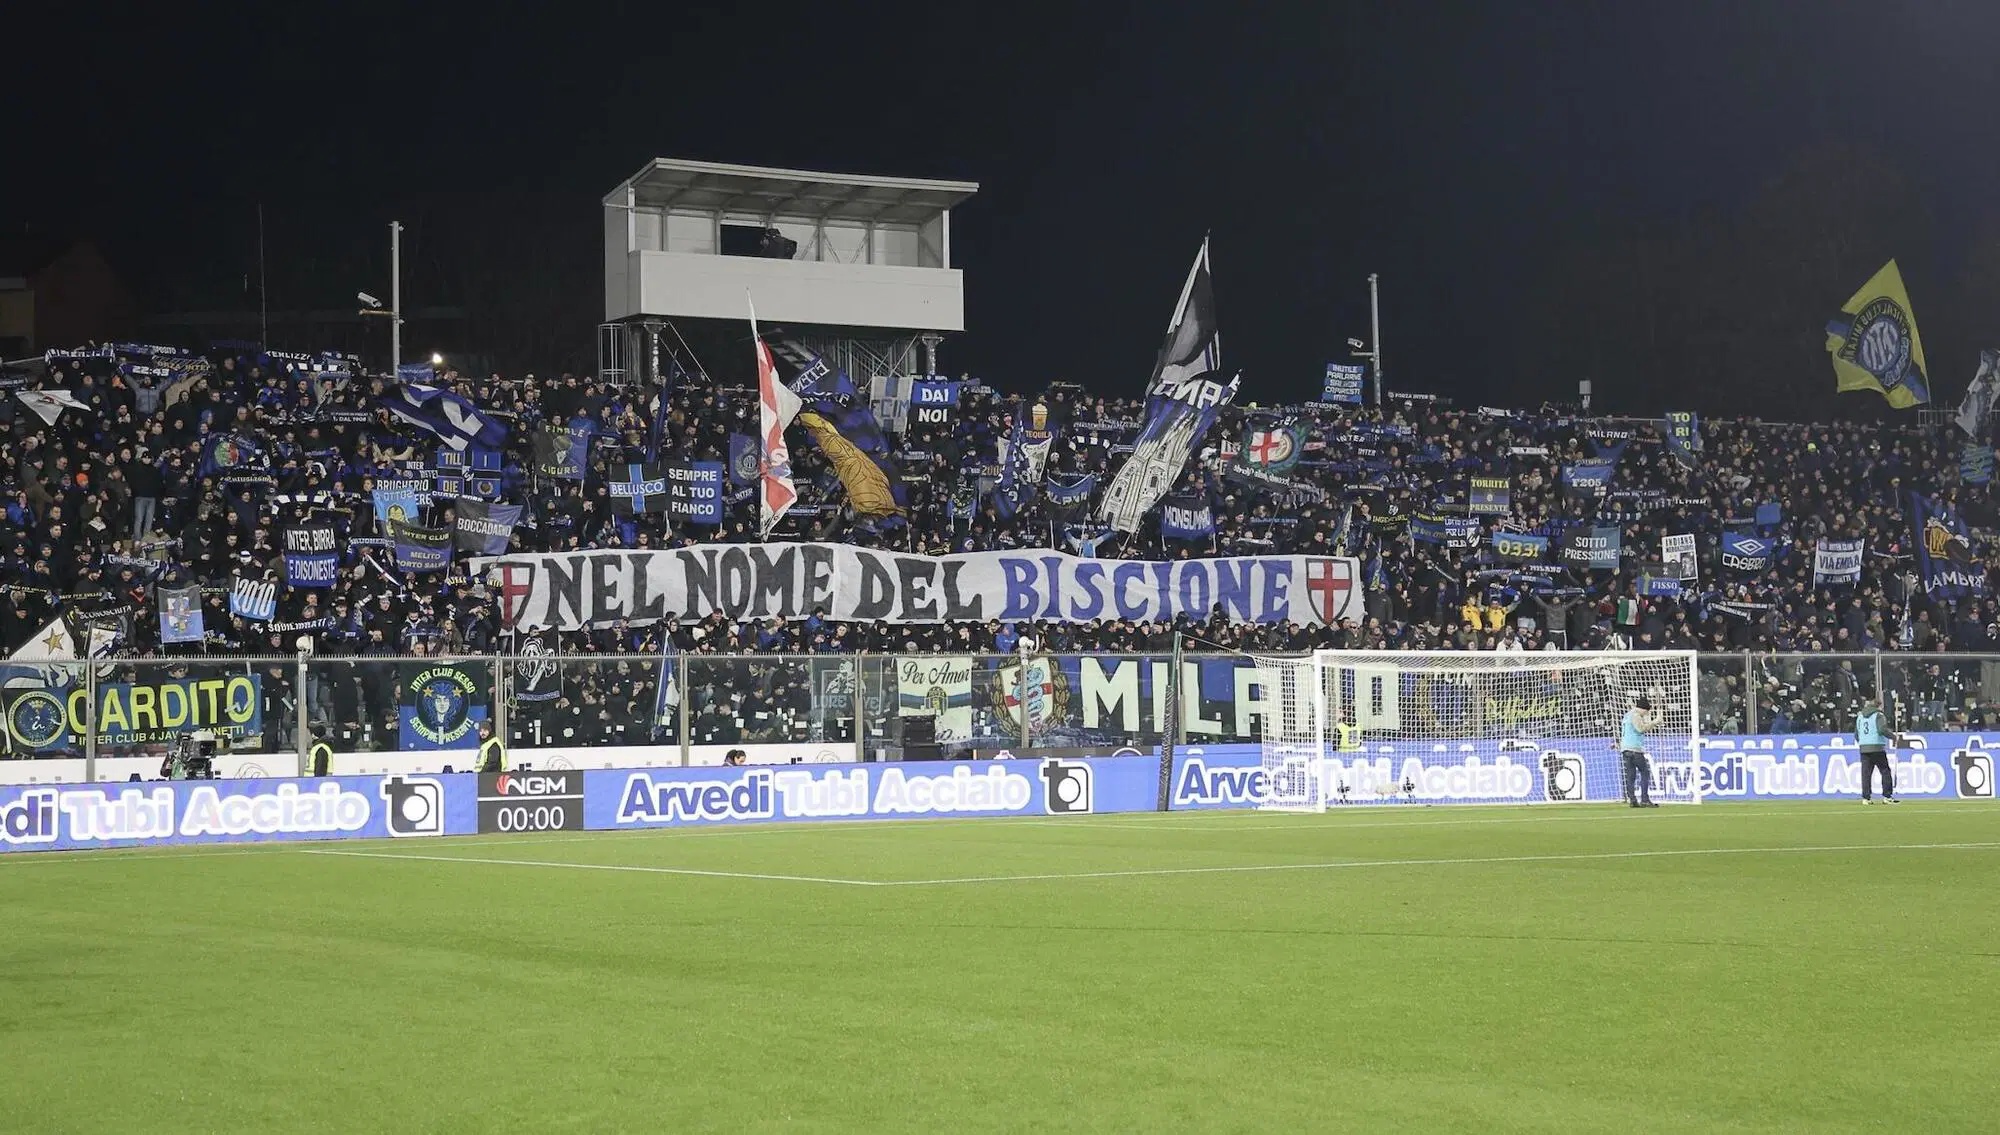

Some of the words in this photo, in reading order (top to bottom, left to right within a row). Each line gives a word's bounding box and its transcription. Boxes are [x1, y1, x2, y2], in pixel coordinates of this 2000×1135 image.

[921, 387, 949, 402] DAI
[918, 408, 948, 423] NOI
[1672, 412, 1691, 423] TO
[545, 425, 585, 438] FINALE
[1025, 430, 1053, 439] TEQUILA
[1589, 430, 1628, 439] MILANO
[1675, 426, 1690, 437] RI
[1336, 435, 1366, 443] INTER
[406, 461, 424, 470] INTER
[483, 454, 487, 467] I
[540, 463, 579, 475] LIGURE
[668, 468, 717, 482] SEMPRE
[442, 480, 459, 493] DIE
[611, 481, 664, 495] BELLUSCO
[1471, 478, 1509, 490] TORRITA
[671, 485, 686, 497] AL
[689, 486, 715, 499] TUO
[671, 501, 714, 515] FIANCO
[1469, 503, 1509, 513] PRESENTE
[313, 527, 336, 552] BIRRA
[429, 532, 450, 542] CLUB
[1575, 536, 1607, 548] SOTTO
[410, 551, 441, 560] MELITO
[1564, 547, 1617, 561] PRESSIONE
[289, 558, 295, 579] E
[295, 557, 336, 581] DISONESTE
[1819, 555, 1835, 570] VIA
[542, 553, 665, 626] NEL
[676, 544, 835, 620] NOME
[851, 551, 983, 620] DEL
[998, 556, 1293, 625] BISCIONE
[1651, 581, 1678, 590] FISSO
[901, 661, 925, 684] Per
[929, 661, 970, 685] Amor
[410, 670, 432, 693] INTER
[432, 667, 453, 677] CLUB
[453, 671, 477, 694] SESSO
[1080, 656, 1400, 737] MILANO
[67, 677, 255, 734] CARDITO
[409, 716, 438, 743] SEMPRE
[1863, 721, 1870, 736] 3
[115, 731, 146, 743] CLUB
[149, 732, 155, 742] 4
[1177, 760, 1310, 803] Arvedi
[1400, 755, 1532, 798] Acciaio
[1748, 754, 1818, 795] Tubi
[506, 775, 566, 795] NGM
[620, 769, 774, 822] Arvedi
[776, 769, 867, 815] Tubi
[875, 766, 1029, 811] Acciaio
[61, 788, 174, 839] Tubi
[183, 784, 370, 835] Acciaio
[497, 806, 565, 831] 00:00
